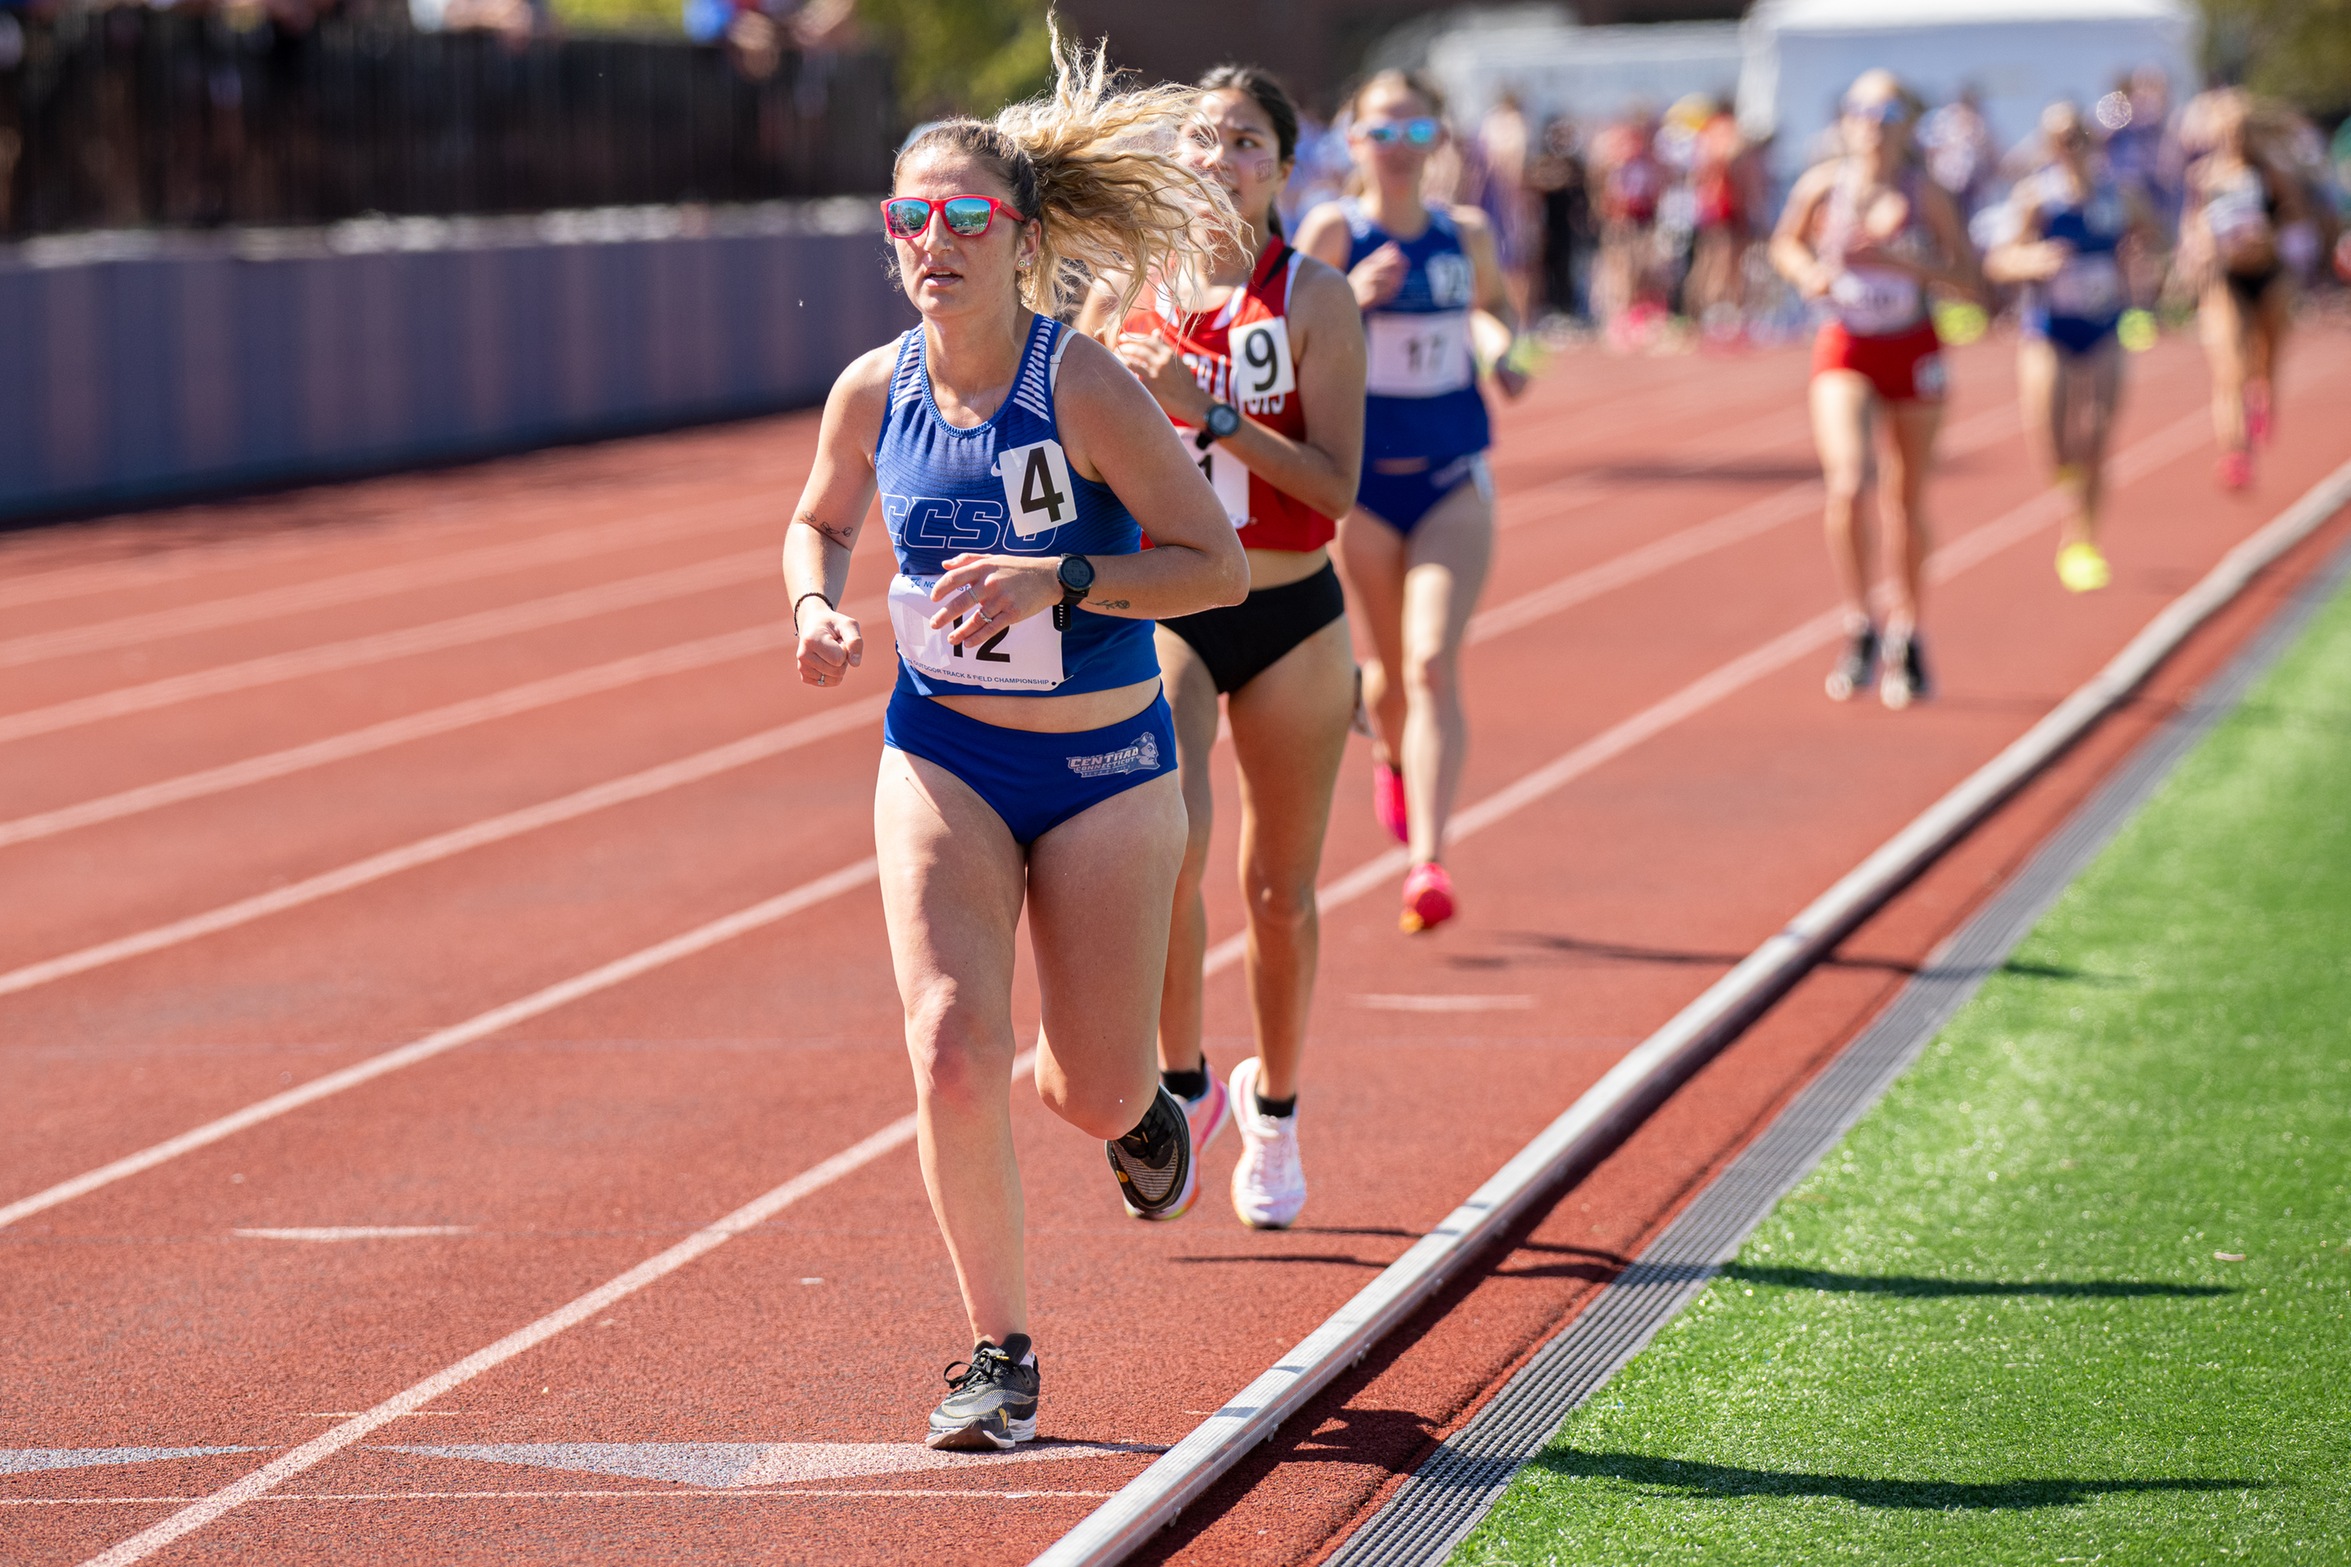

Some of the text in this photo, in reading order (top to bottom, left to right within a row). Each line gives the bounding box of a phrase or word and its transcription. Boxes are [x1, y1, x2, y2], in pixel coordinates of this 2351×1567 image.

[1245, 328, 1278, 391] 9
[1020, 446, 1065, 523] 4
[943, 669, 966, 679] TRACK
[973, 674, 993, 682] FIELD
[994, 676, 1049, 685] CHAMPIONSHIP
[1076, 757, 1135, 771] CONNECTICUT
